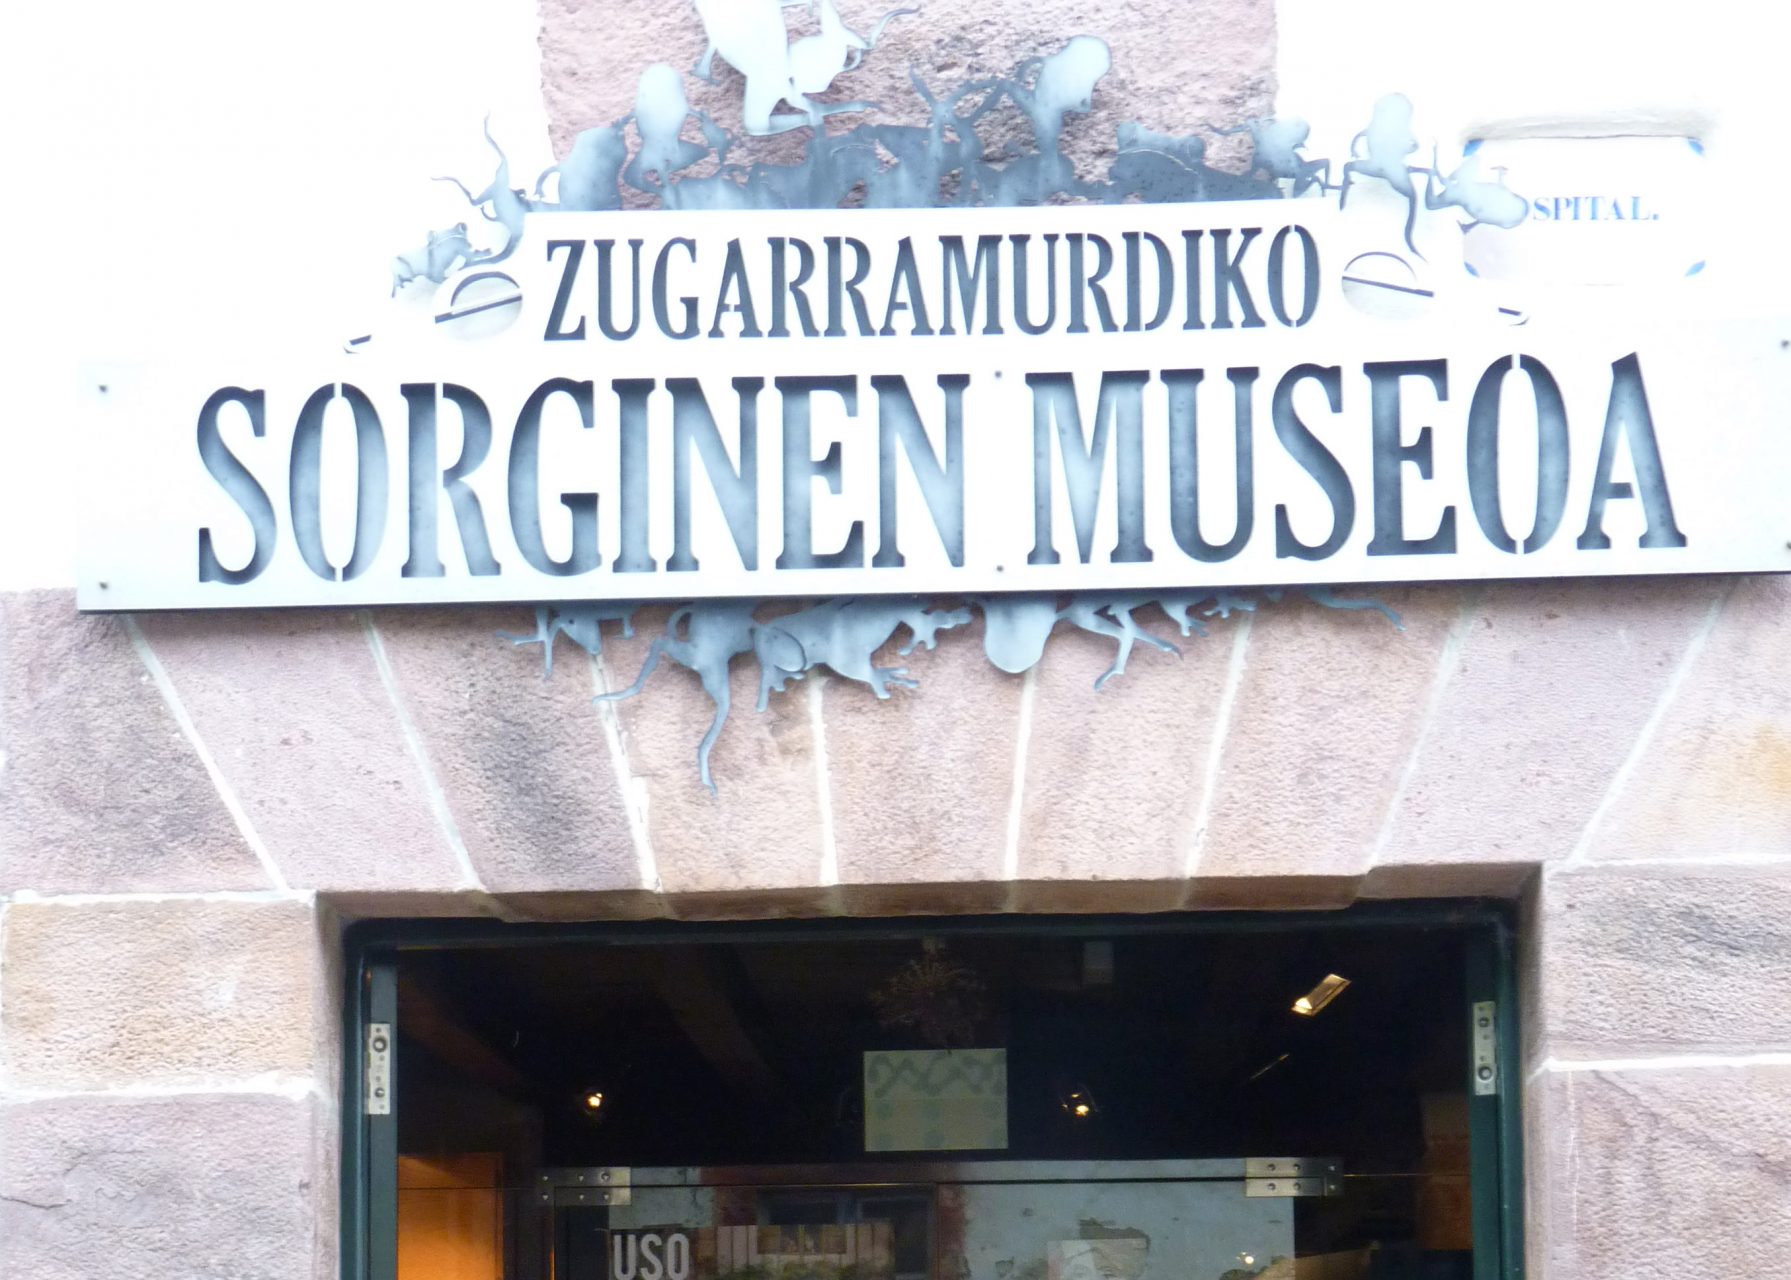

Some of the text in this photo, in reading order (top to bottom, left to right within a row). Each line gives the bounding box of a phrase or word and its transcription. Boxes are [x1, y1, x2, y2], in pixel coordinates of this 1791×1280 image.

[1533, 196, 1659, 221] SPITAL.
[543, 224, 1321, 341] ZUGARRAMURDIKO
[197, 351, 1688, 585] SORGINEN MUSEOA
